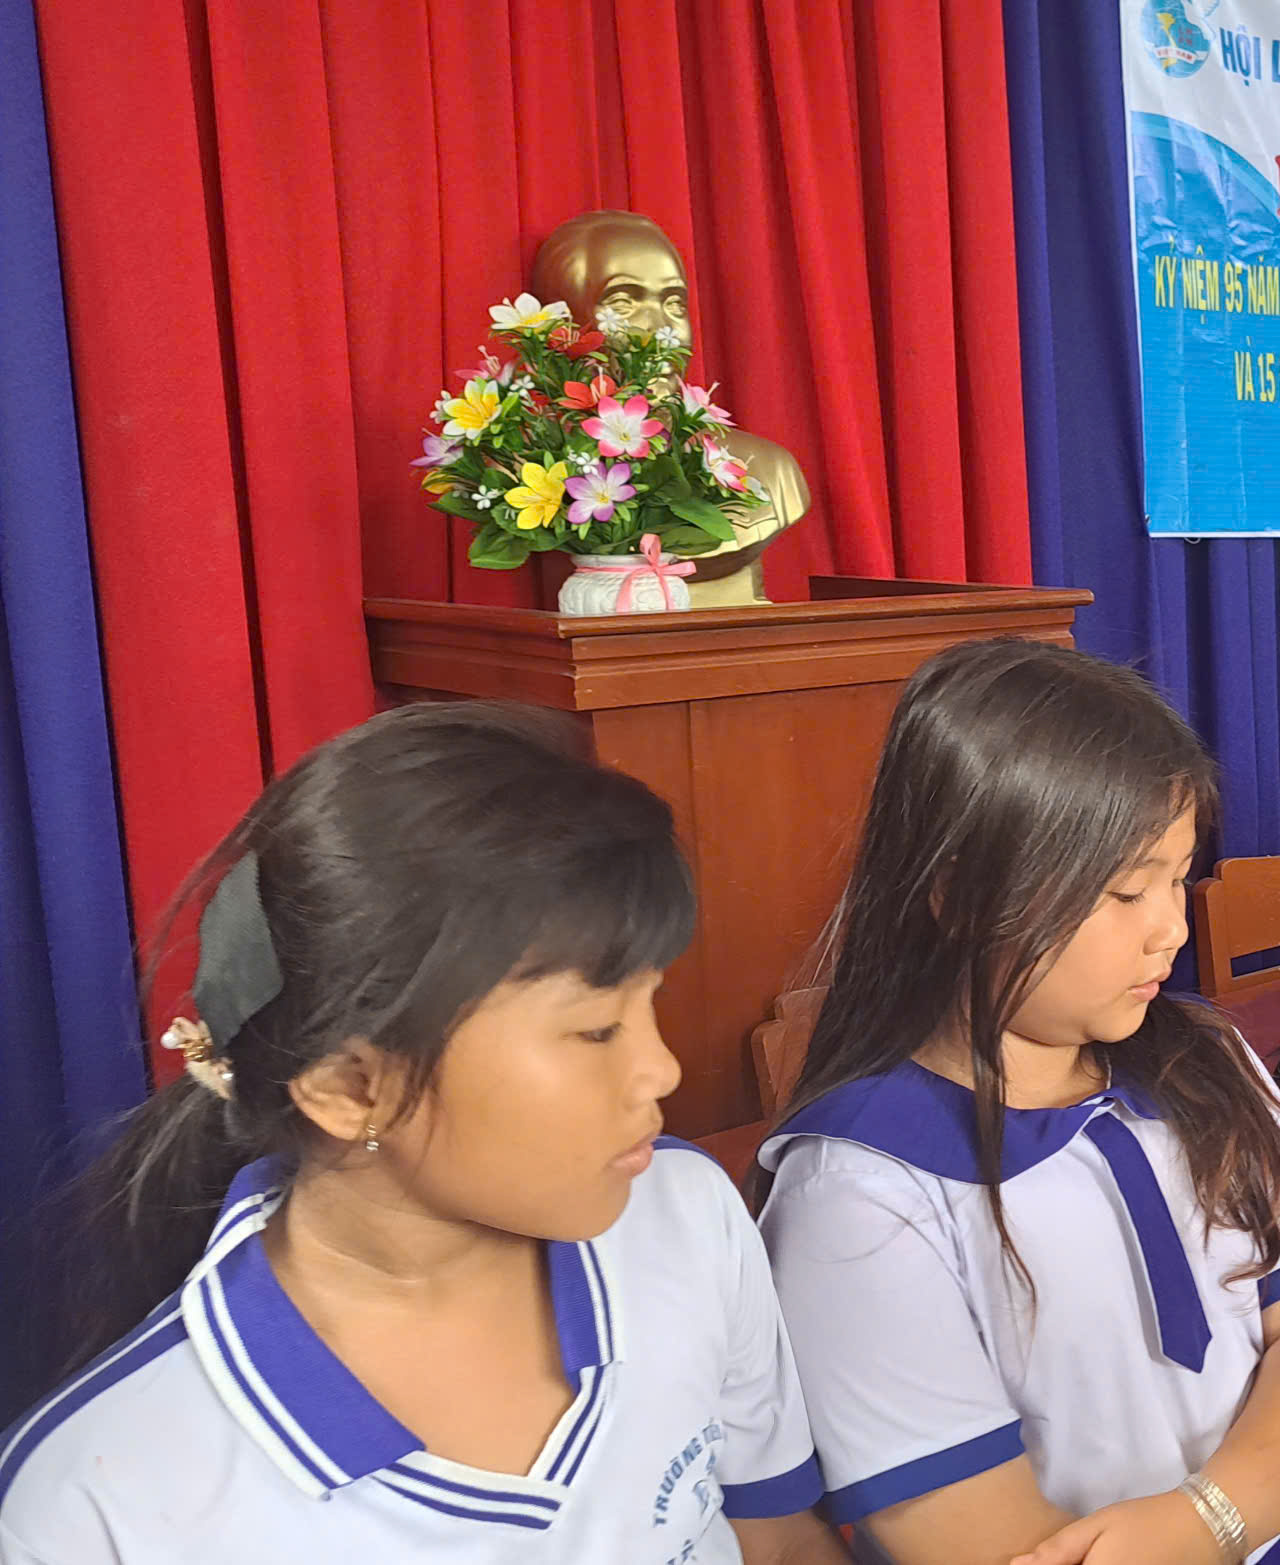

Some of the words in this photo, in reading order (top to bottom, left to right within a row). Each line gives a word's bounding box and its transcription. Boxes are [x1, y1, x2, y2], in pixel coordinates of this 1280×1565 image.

[1219, 24, 1262, 87] HỘI
[1182, 244, 1220, 326] NIỆM
[1225, 261, 1244, 313] 95
[1248, 255, 1280, 317] NĂM
[1234, 335, 1256, 401] VÀ
[1258, 352, 1276, 403] 15
